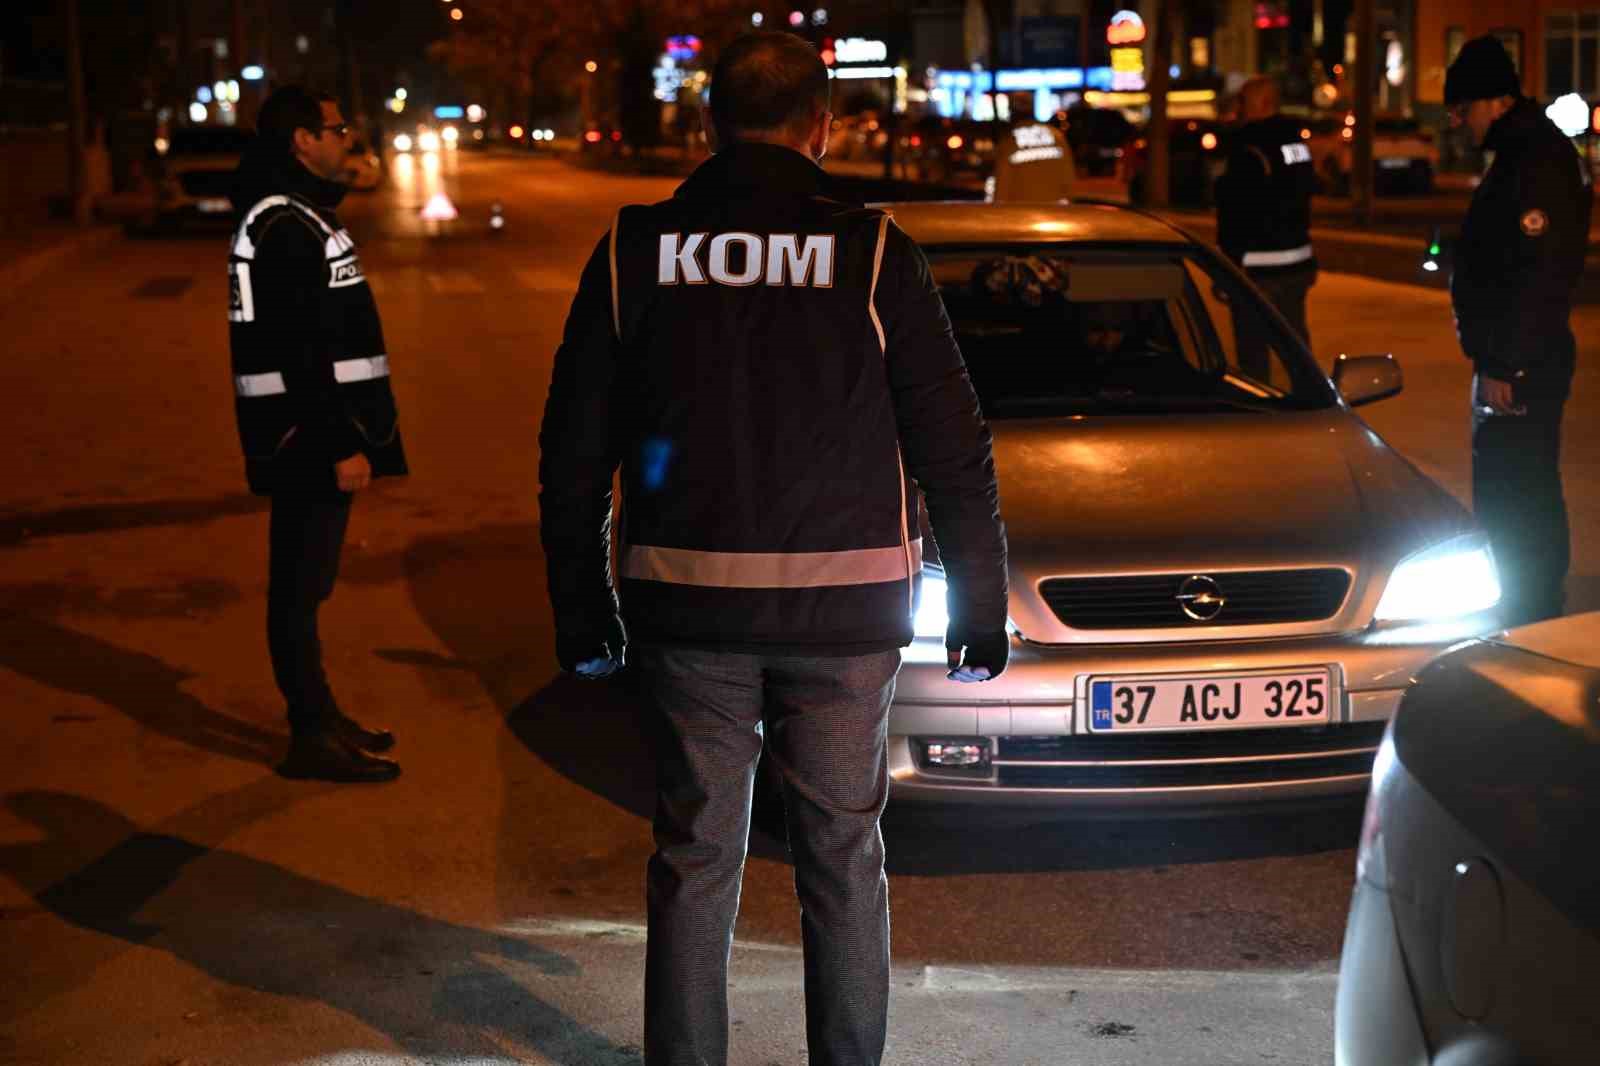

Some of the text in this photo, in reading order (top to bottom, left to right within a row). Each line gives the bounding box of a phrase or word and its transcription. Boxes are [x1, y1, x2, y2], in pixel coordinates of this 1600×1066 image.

[657, 232, 835, 288] KOM
[1095, 678, 1324, 724] TR 37 ACJ 325
